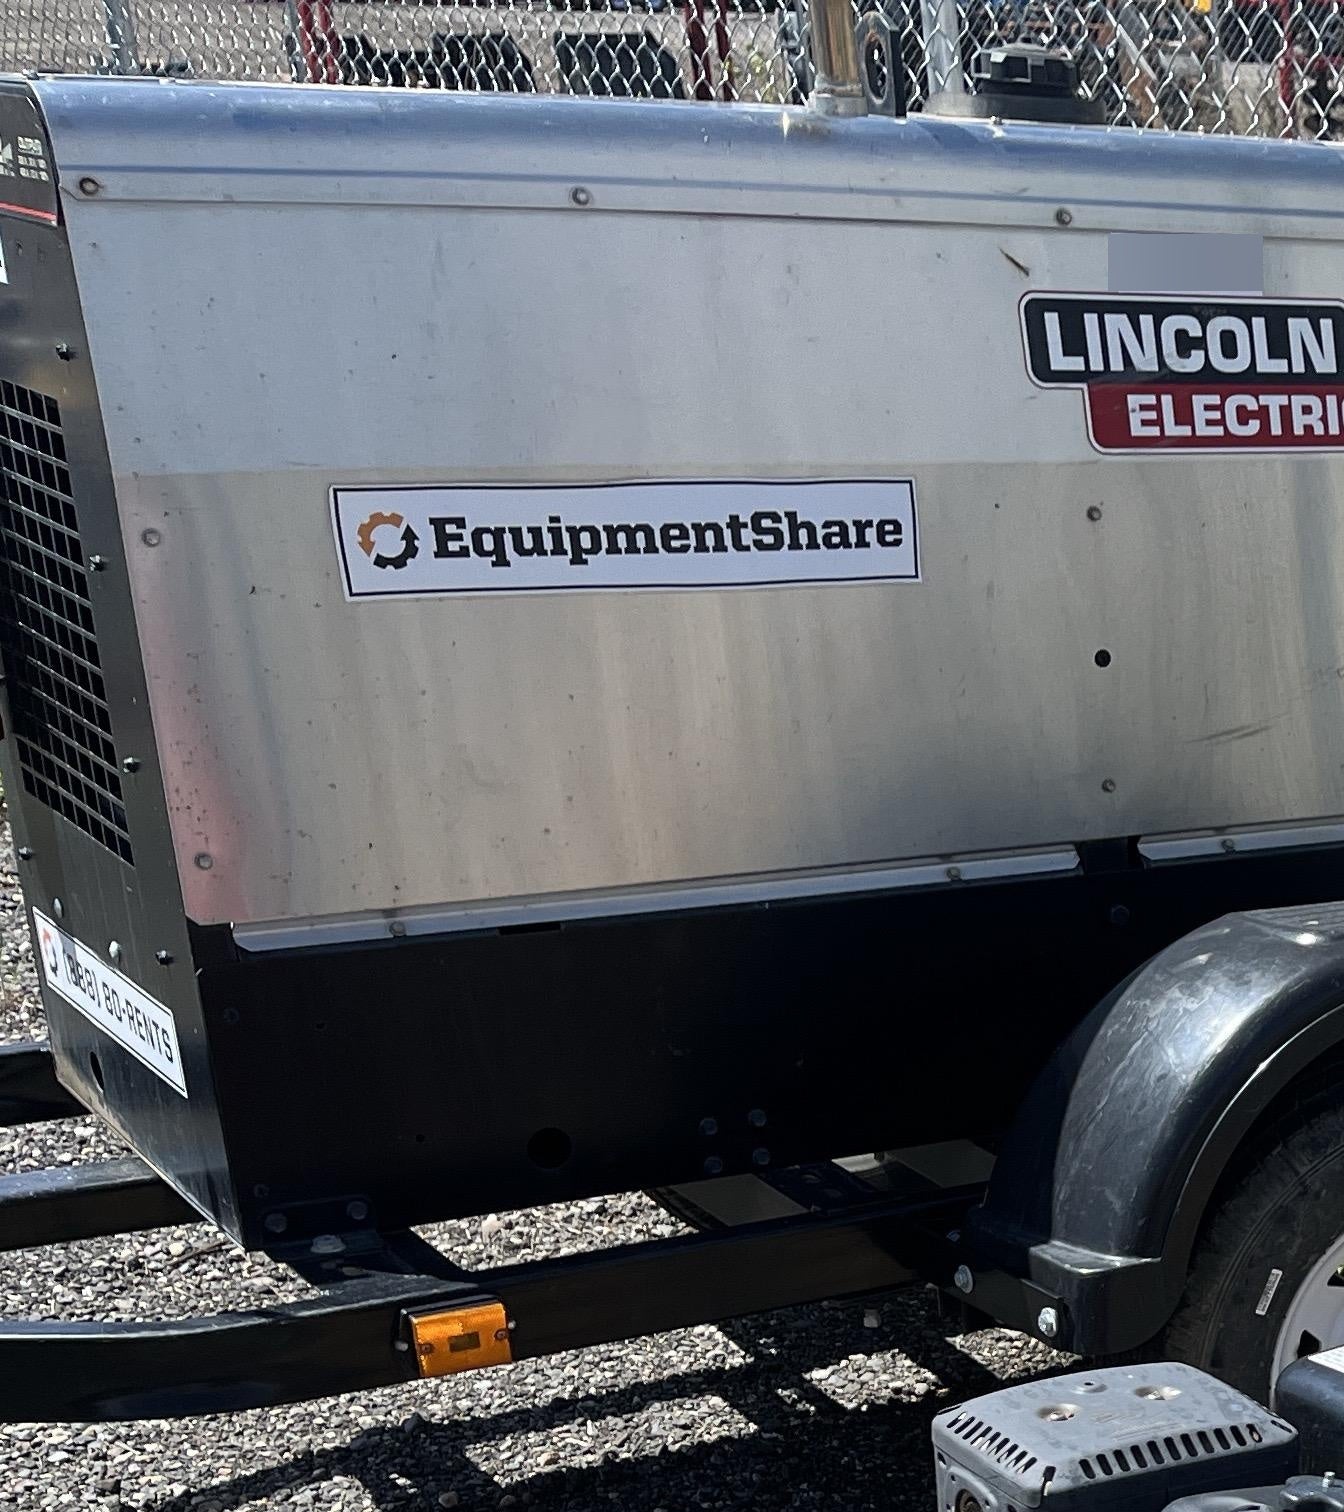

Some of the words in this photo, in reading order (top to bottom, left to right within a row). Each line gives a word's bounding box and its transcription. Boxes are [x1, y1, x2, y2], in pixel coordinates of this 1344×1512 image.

[1043, 311, 1337, 375] LINCOLN
[428, 510, 904, 568] EquipmentShare
[63, 951, 101, 1008] (888)
[102, 981, 174, 1063] 80-RENTS
